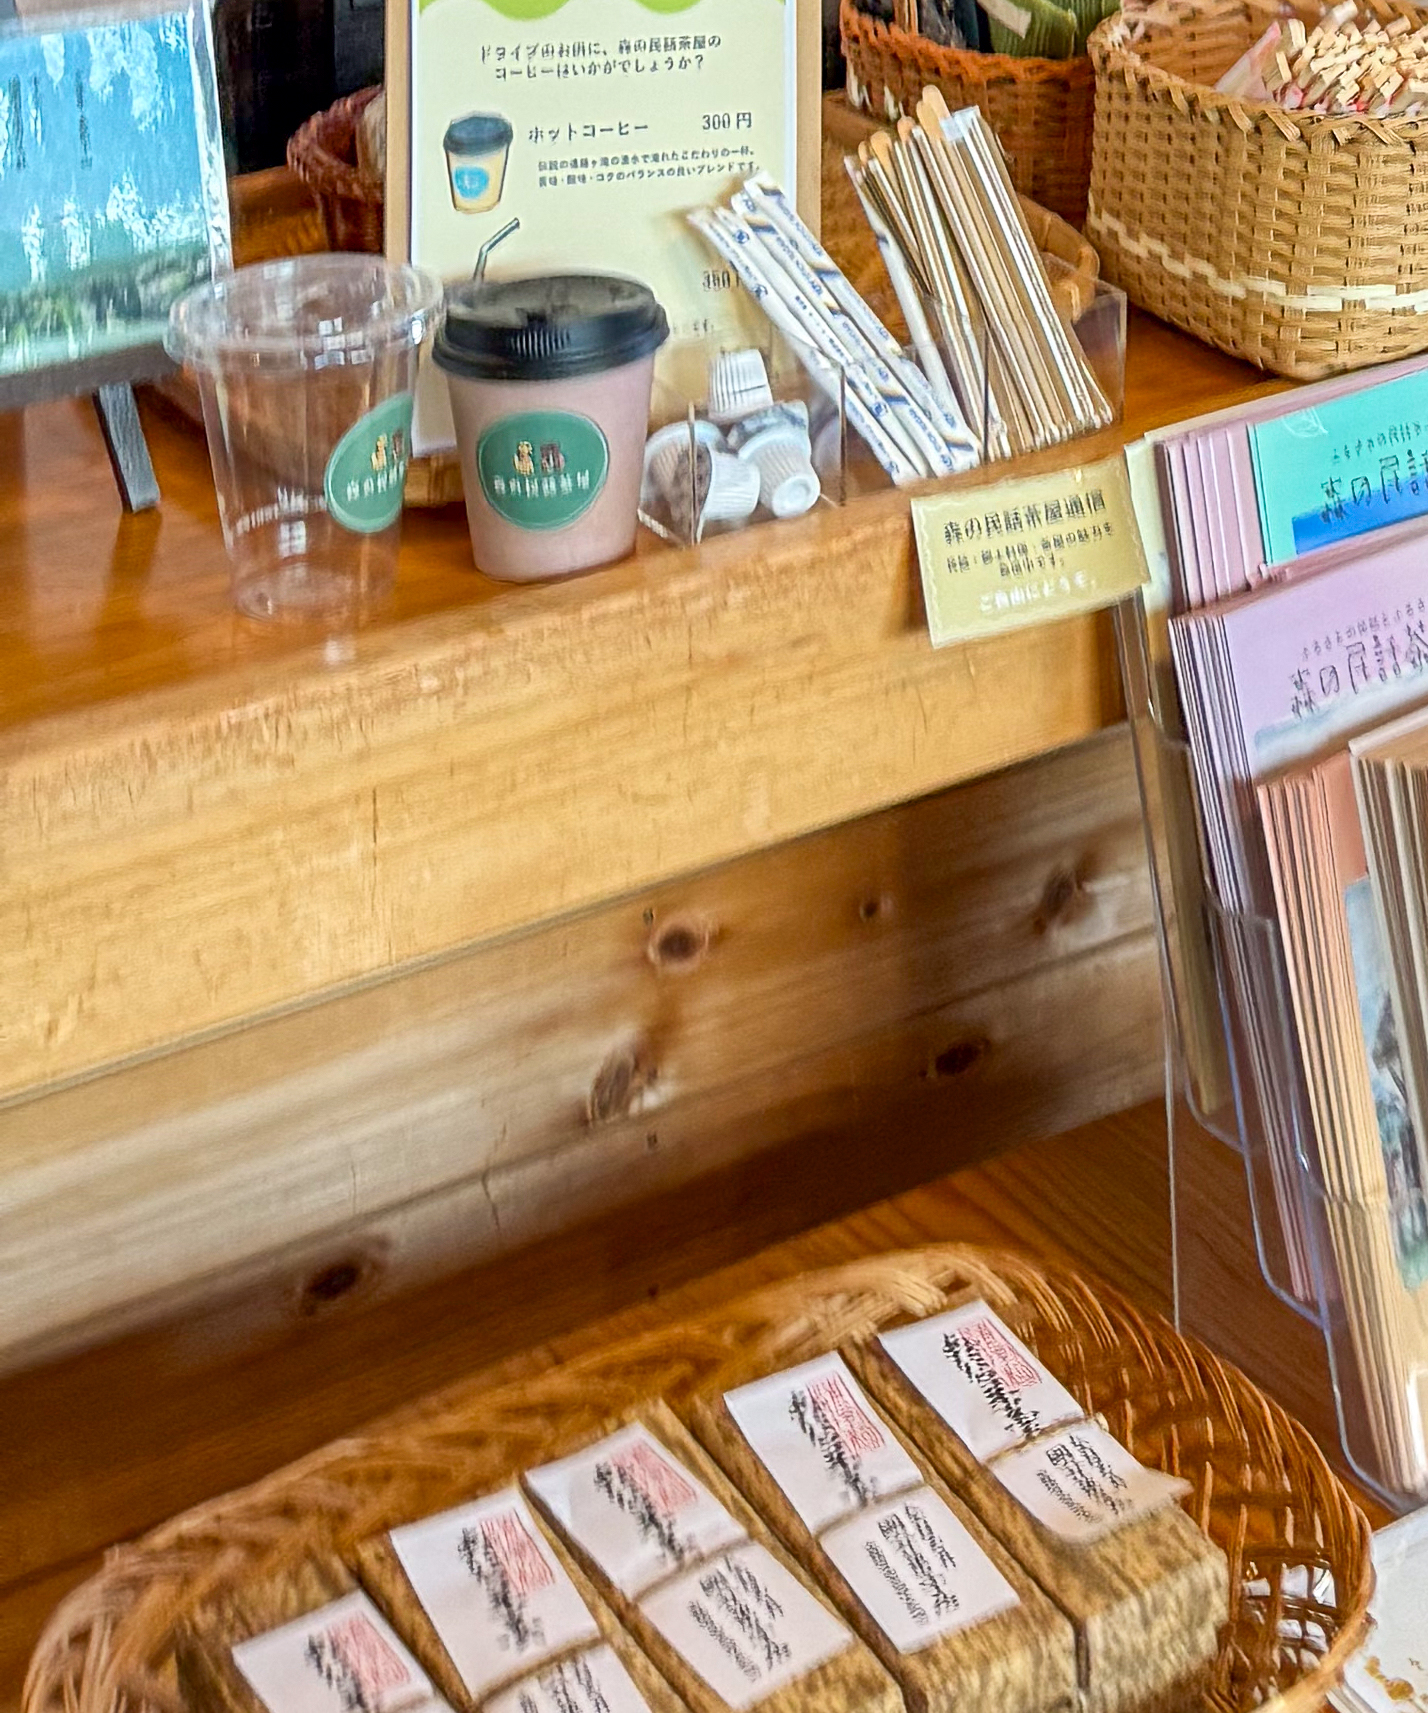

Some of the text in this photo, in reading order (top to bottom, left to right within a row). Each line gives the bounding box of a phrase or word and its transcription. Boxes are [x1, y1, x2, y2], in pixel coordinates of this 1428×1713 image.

[528, 120, 649, 145] ホットコーヒー
[943, 489, 1107, 545] 森の民話茶屋通信
